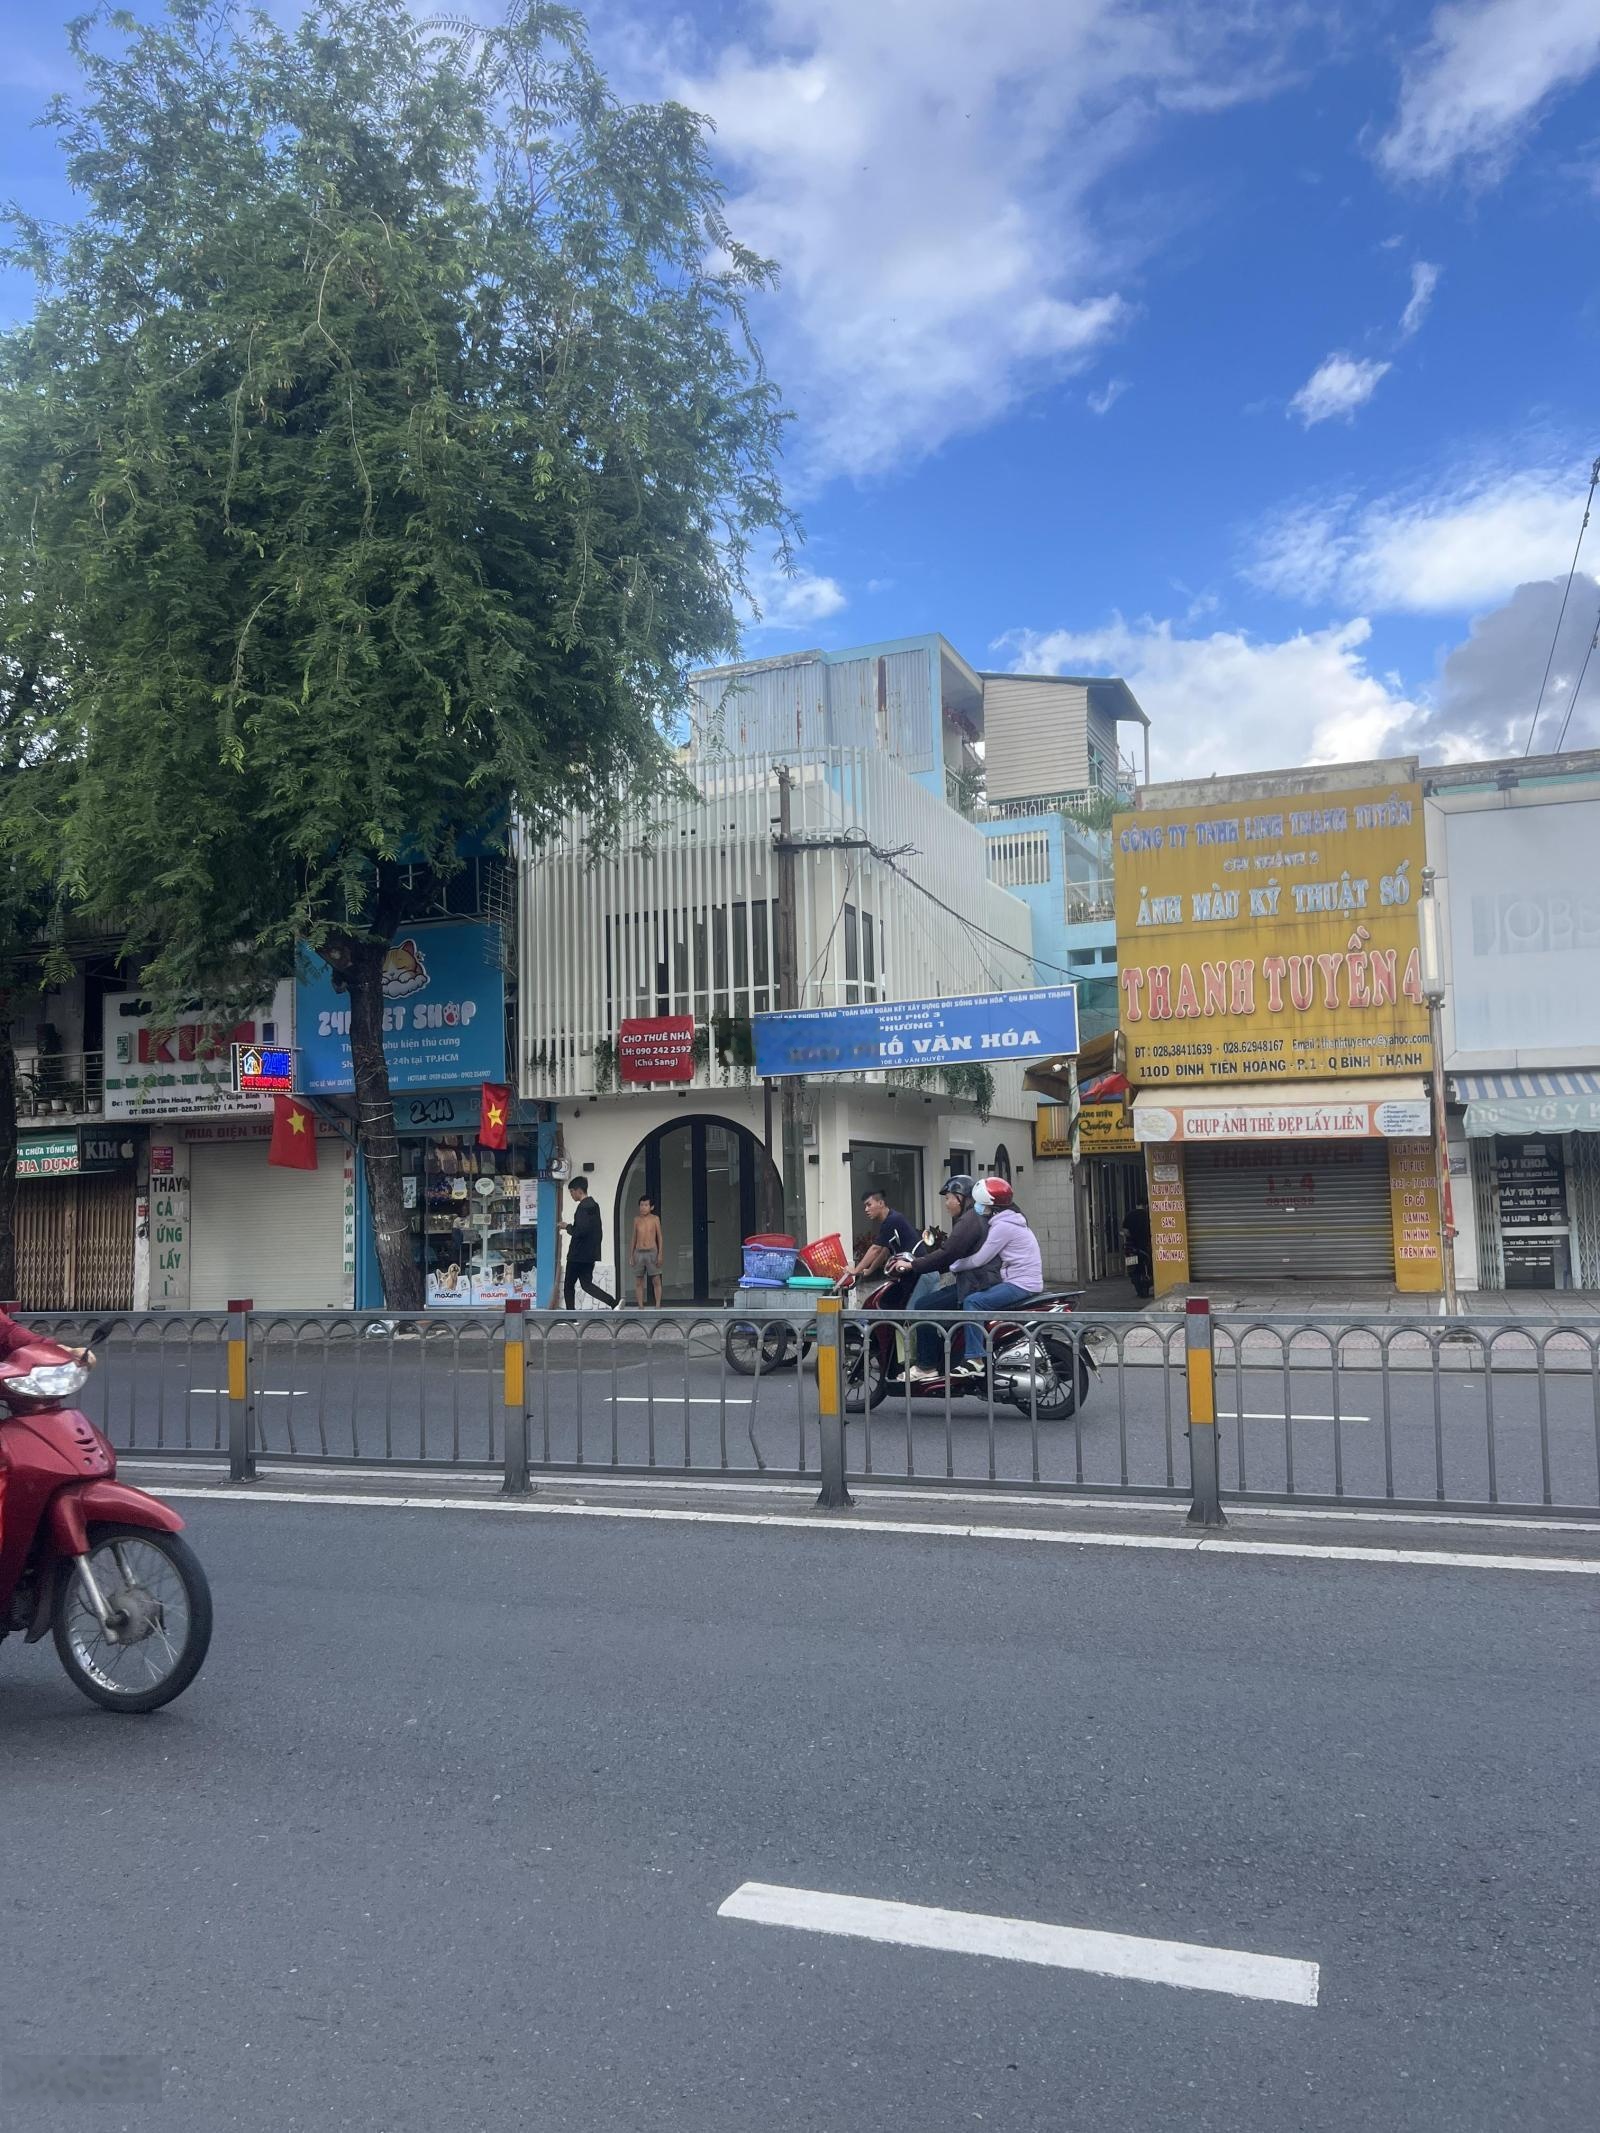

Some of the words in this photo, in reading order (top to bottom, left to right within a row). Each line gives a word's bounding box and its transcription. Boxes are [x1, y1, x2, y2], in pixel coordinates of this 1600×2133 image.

[1120, 821, 1163, 852] CÔNG
[1168, 823, 1189, 848] TY
[1195, 818, 1240, 846] TNHH
[1245, 814, 1284, 841] LINH
[1289, 807, 1347, 836] THANH
[1354, 791, 1413, 829] TUYỀN
[1310, 851, 1319, 865] 2
[1136, 886, 1183, 927] ẢNH
[1192, 882, 1240, 922] MÀU
[1249, 878, 1282, 917] KỸ
[1291, 871, 1369, 918] THUẬT
[1379, 859, 1410, 906] SỐ
[1121, 959, 1255, 1022] THANH
[1263, 925, 1397, 1013] TUYỀN
[1403, 947, 1424, 1005] 4
[907, 1003, 920, 1011] XÂY
[921, 1002, 940, 1011] DỰNG
[955, 998, 973, 1007] SỐNG
[974, 997, 988, 1005] VĂN
[1009, 994, 1028, 1003] QUẬN
[1029, 992, 1046, 1000] BÌNH
[1048, 991, 1071, 999] THẠNH
[905, 1012, 929, 1020] PHỐ
[400, 1038, 419, 1050] kiện
[439, 1037, 460, 1048] cưng
[622, 1035, 641, 1043] CHO
[643, 1032, 668, 1042] THUÊ
[670, 1031, 692, 1041] NHÀ
[912, 1034, 973, 1054] VĂN
[981, 1028, 1041, 1048] HÓA
[621, 1048, 635, 1056] LH:
[636, 1047, 651, 1055] 090
[652, 1046, 669, 1054] 242
[670, 1045, 692, 1054] 2592
[1223, 1040, 1284, 1055] 028.62948167
[262, 1051, 289, 1076] 24H
[393, 1057, 409, 1066] 24h
[411, 1055, 423, 1066] tại
[425, 1053, 459, 1063] TP.HCM
[654, 1058, 678, 1067] Sang)
[905, 1056, 920, 1064] VĂN
[922, 1055, 945, 1063] DUYỆT
[1140, 1066, 1170, 1078] 110D
[1176, 1063, 1204, 1076] ĐINH
[1210, 1060, 1238, 1074] TIÊN
[1243, 1056, 1287, 1073] HOÀNG
[1327, 1056, 1338, 1071] Q
[1340, 1052, 1371, 1069] BÌNH
[1378, 1053, 1423, 1068] THẠNH
[1525, 1100, 1558, 1121] VỚ
[1566, 1103, 1580, 1121] Y
[1186, 1117, 1220, 1137] CHỤP
[1222, 1112, 1248, 1134] ẢNH
[1250, 1111, 1275, 1132] THẺ
[1278, 1115, 1303, 1136] ĐẸP
[1306, 1110, 1331, 1131] LẤY
[1334, 1107, 1364, 1131] LIỀN
[185, 1128, 213, 1139] MUA
[217, 1126, 248, 1140] ĐIỆN
[25, 1146, 44, 1156] CHỮA
[85, 1140, 118, 1160] KIM
[16, 1159, 38, 1174] GIA
[41, 1156, 79, 1175] DỤNG
[1410, 1160, 1425, 1172] FILE
[1510, 1159, 1518, 1169] Y
[1521, 1158, 1549, 1169] KHOA
[153, 1178, 183, 1192] THAY
[1302, 1173, 1315, 1192] 4
[1152, 1184, 1169, 1196] ALBUM
[1518, 1187, 1534, 1198] TRỢ
[1404, 1193, 1413, 1206] ÉP
[1403, 1212, 1431, 1225] LAMINA
[156, 1224, 182, 1242] ỨNG
[1403, 1231, 1412, 1242] IN
[1413, 1227, 1431, 1242] HÌNH
[1399, 1244, 1419, 1258] TRÊN
[1419, 1244, 1437, 1258] KÍNH
[159, 1249, 182, 1270] LẤY
[434, 1291, 462, 1299] maxime
[480, 1291, 508, 1299] maxime
